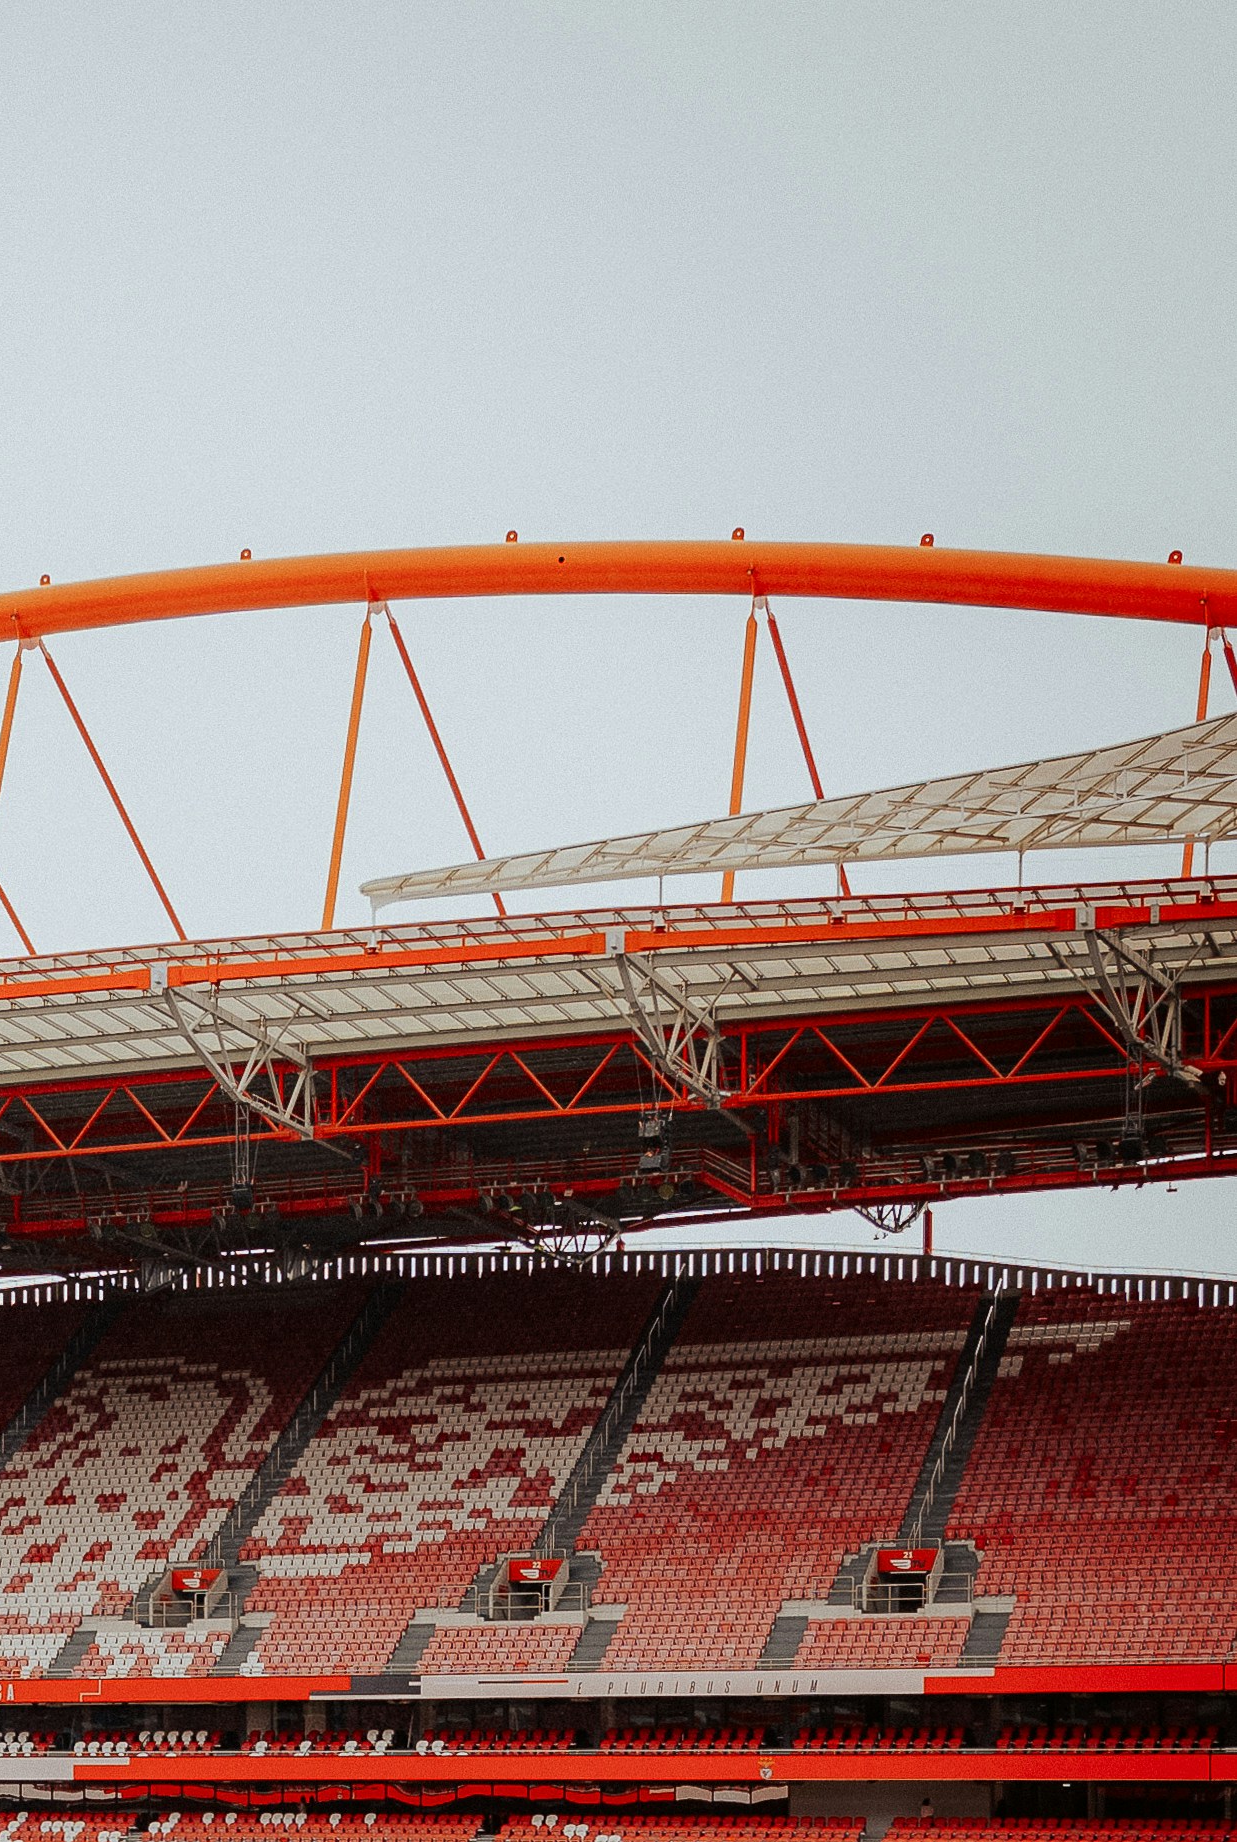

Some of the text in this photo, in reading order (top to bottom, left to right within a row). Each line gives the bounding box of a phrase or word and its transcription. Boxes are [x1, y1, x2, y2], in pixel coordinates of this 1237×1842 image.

[903, 1551, 913, 1559] 21
[532, 1561, 541, 1569] 22
[577, 1680, 818, 1695] E PLURIBUS UNUM
